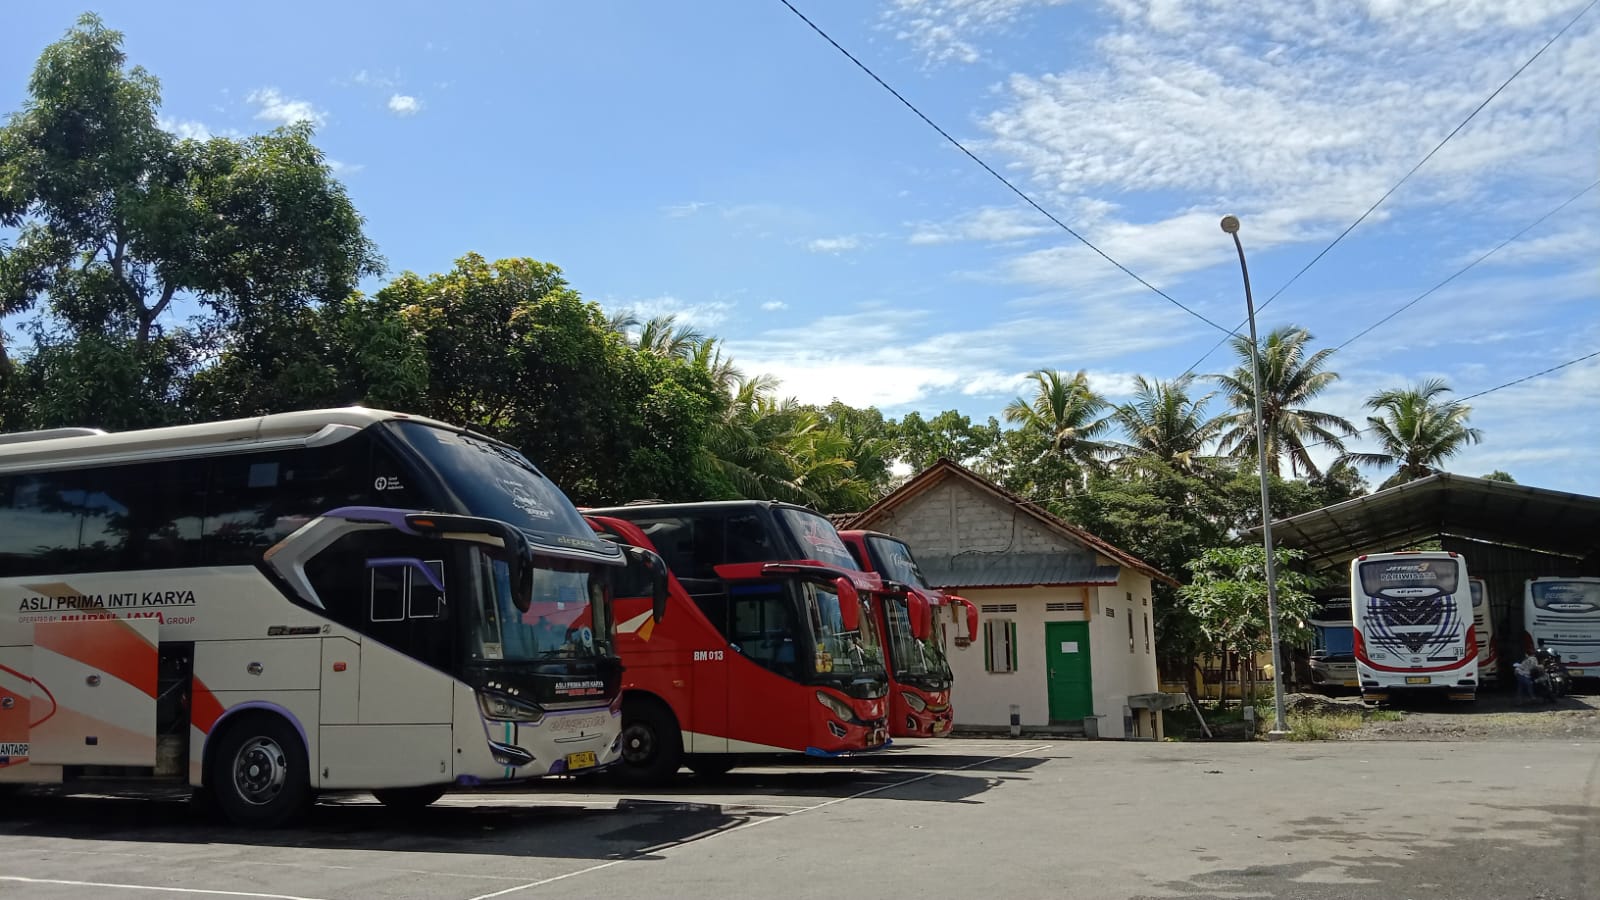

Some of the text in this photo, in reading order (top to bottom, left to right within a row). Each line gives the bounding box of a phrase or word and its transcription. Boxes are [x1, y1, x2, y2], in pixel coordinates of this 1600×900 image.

[18, 590, 196, 610] ASLI PRIMA INTI KARYA
[166, 616, 195, 625] GROUP
[694, 650, 724, 661] BM 013
